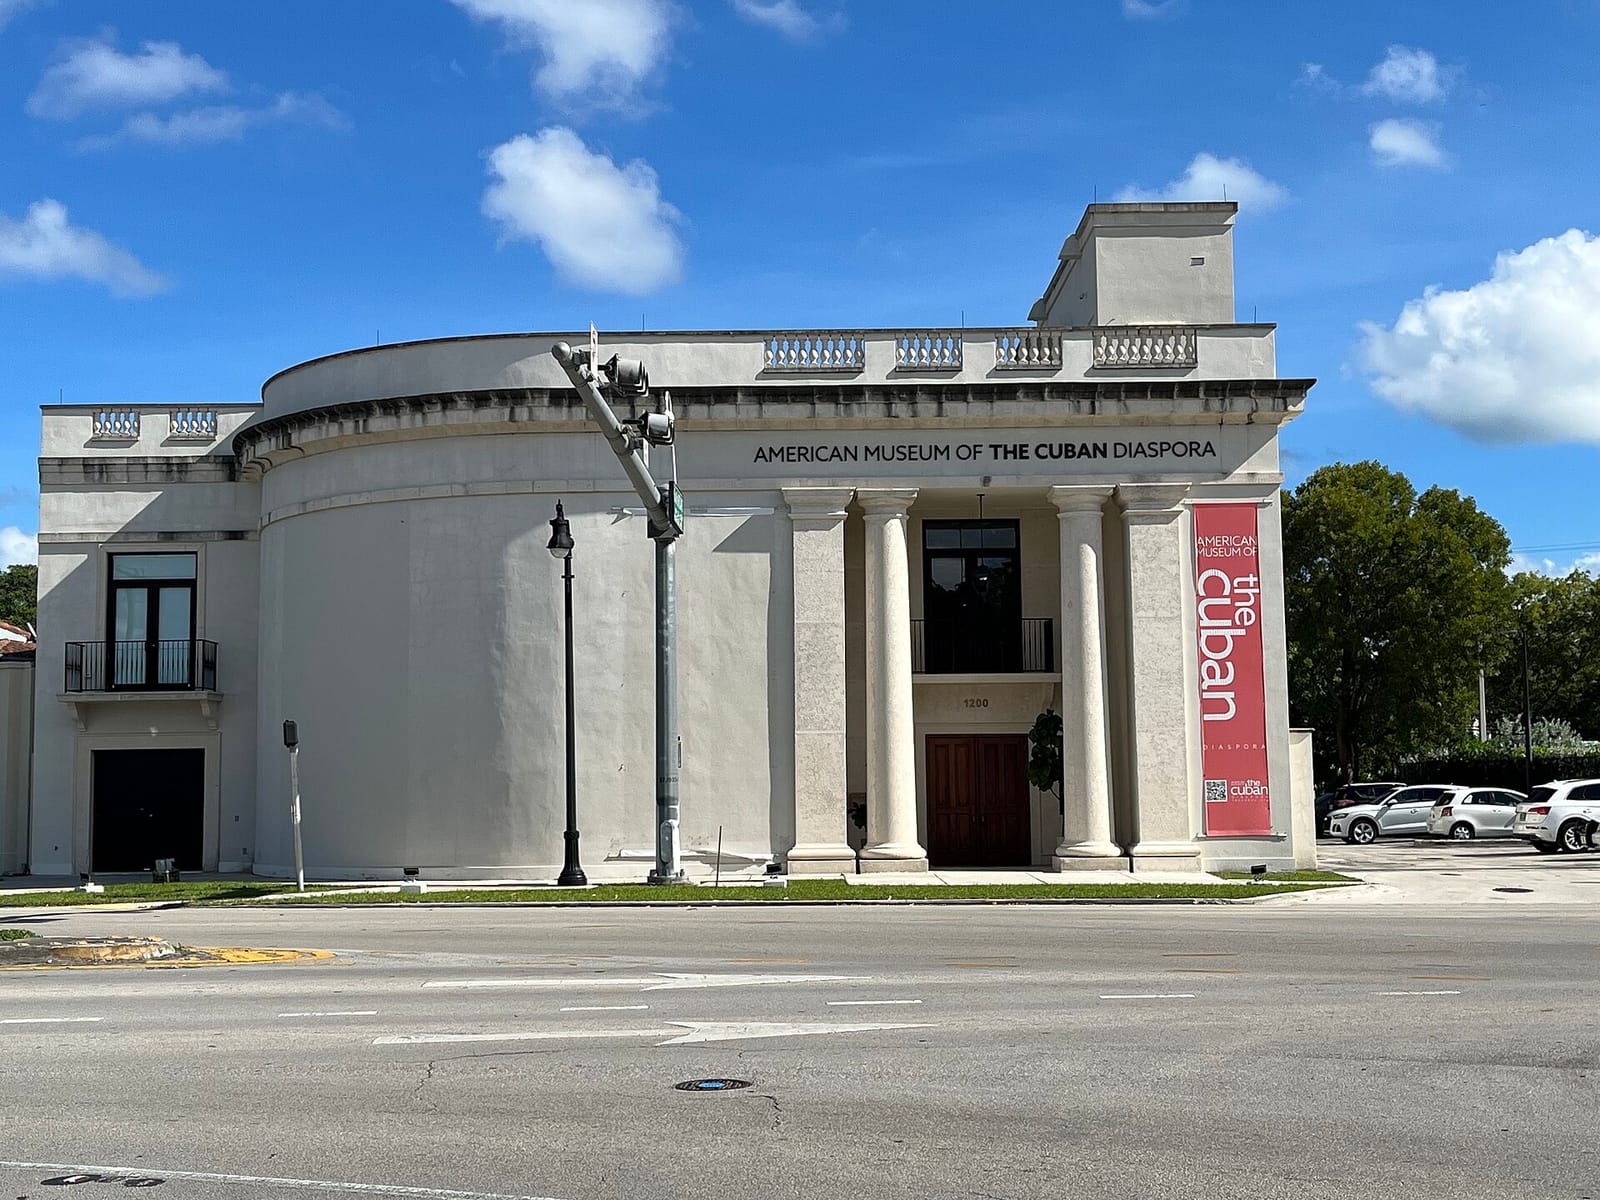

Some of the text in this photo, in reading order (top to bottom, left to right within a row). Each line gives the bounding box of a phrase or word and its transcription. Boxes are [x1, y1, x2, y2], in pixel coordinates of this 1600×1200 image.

[753, 441, 1217, 463] AMERICAN MUSEUM OF THE CUBAN DIASPORA
[1197, 535, 1257, 547] AMERICAN
[1197, 546, 1257, 557] MUSEUM OF
[1233, 573, 1260, 626] the
[1197, 568, 1246, 721] cuban
[963, 698, 989, 708] 1200
[1203, 743, 1266, 751] DIASPORA
[1230, 782, 1269, 796] cuban
[1246, 779, 1261, 787] the
